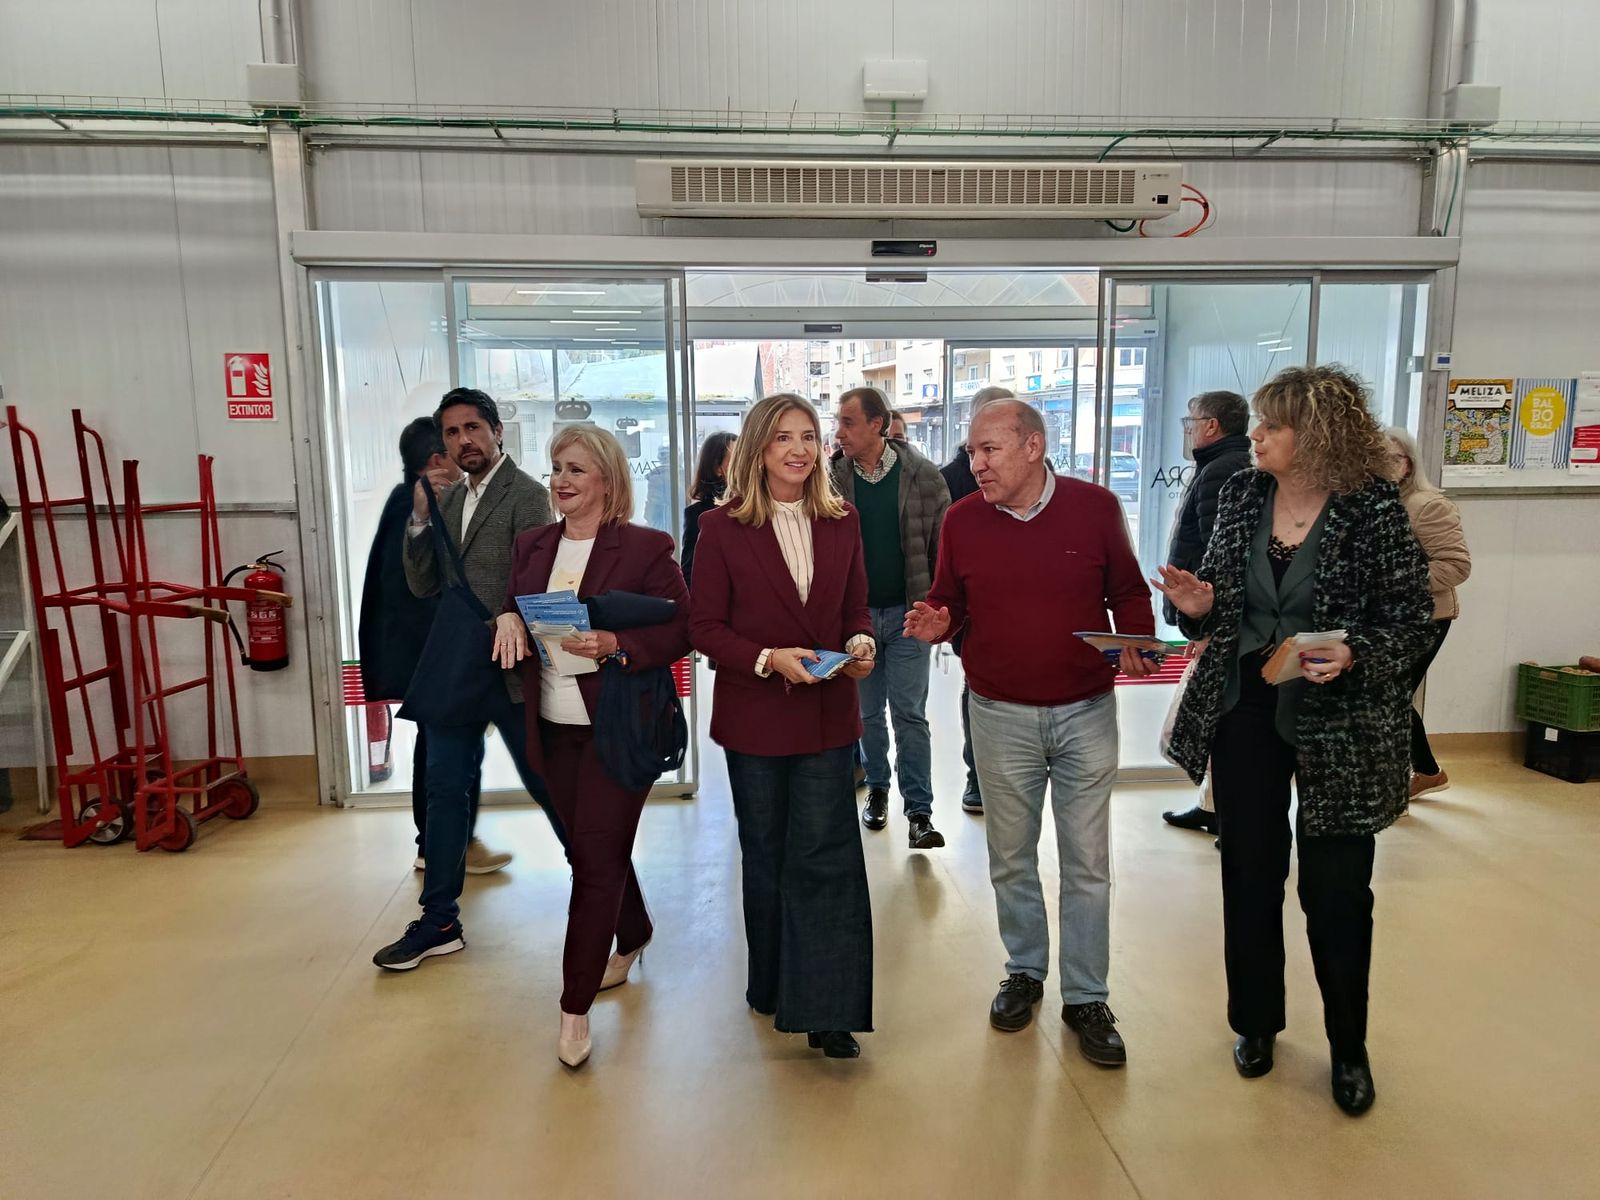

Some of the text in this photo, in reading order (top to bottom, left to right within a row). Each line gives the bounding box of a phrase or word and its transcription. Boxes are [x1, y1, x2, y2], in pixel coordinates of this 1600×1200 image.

[1460, 386, 1502, 396] MELIZA
[229, 404, 272, 416] EXTINTOR
[1531, 409, 1554, 422] BO
